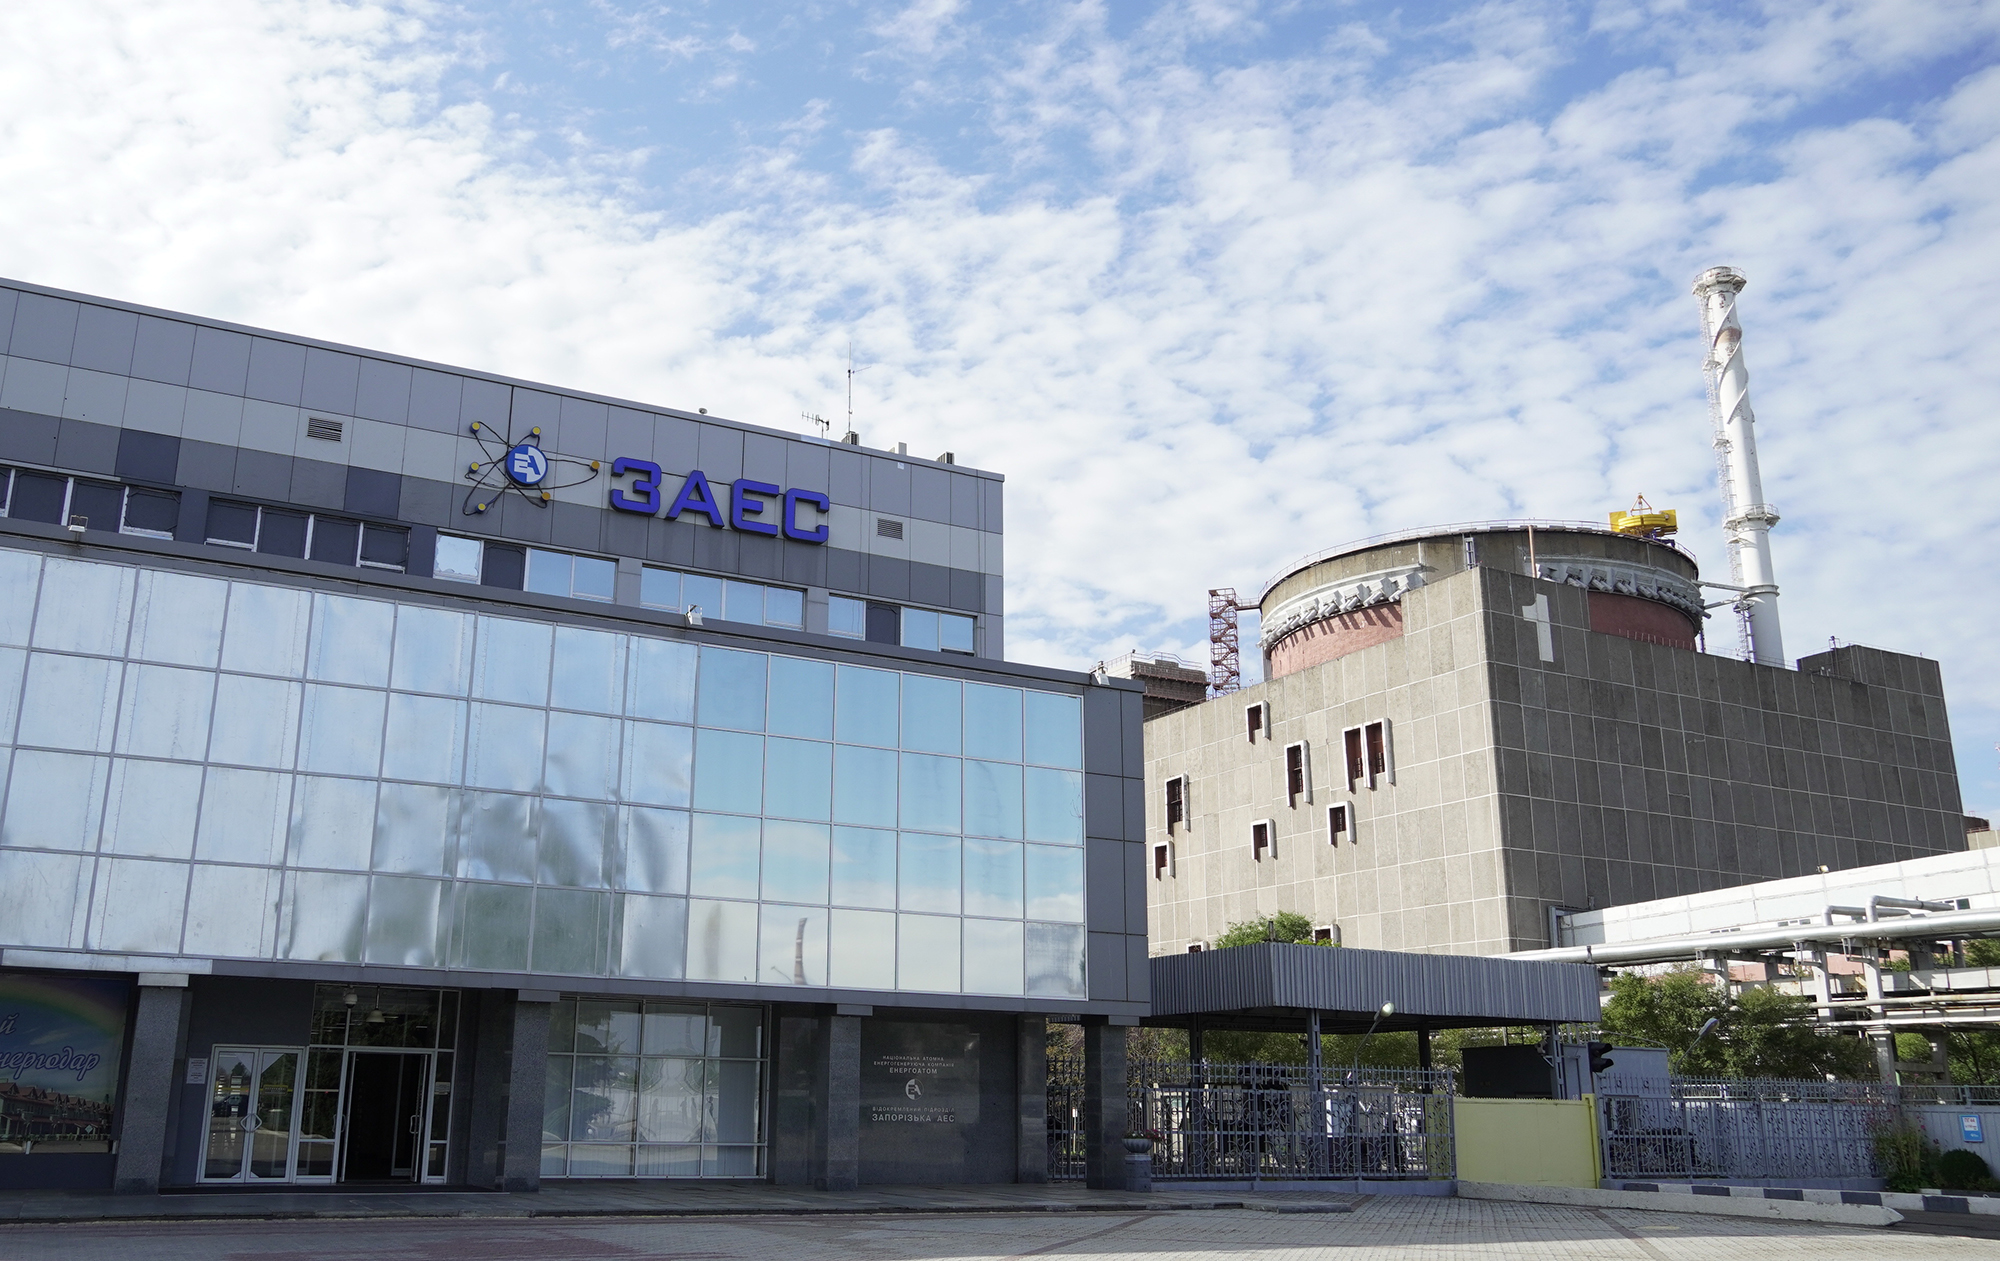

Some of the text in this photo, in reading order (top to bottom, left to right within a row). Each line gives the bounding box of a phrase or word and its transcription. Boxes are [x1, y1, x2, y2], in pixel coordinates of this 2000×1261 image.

[611, 457, 830, 544] ЗАЕС
[1522, 593, 1554, 662] 1
[872, 1113, 955, 1122] ЗАПОРІЗЬКА АЕС
